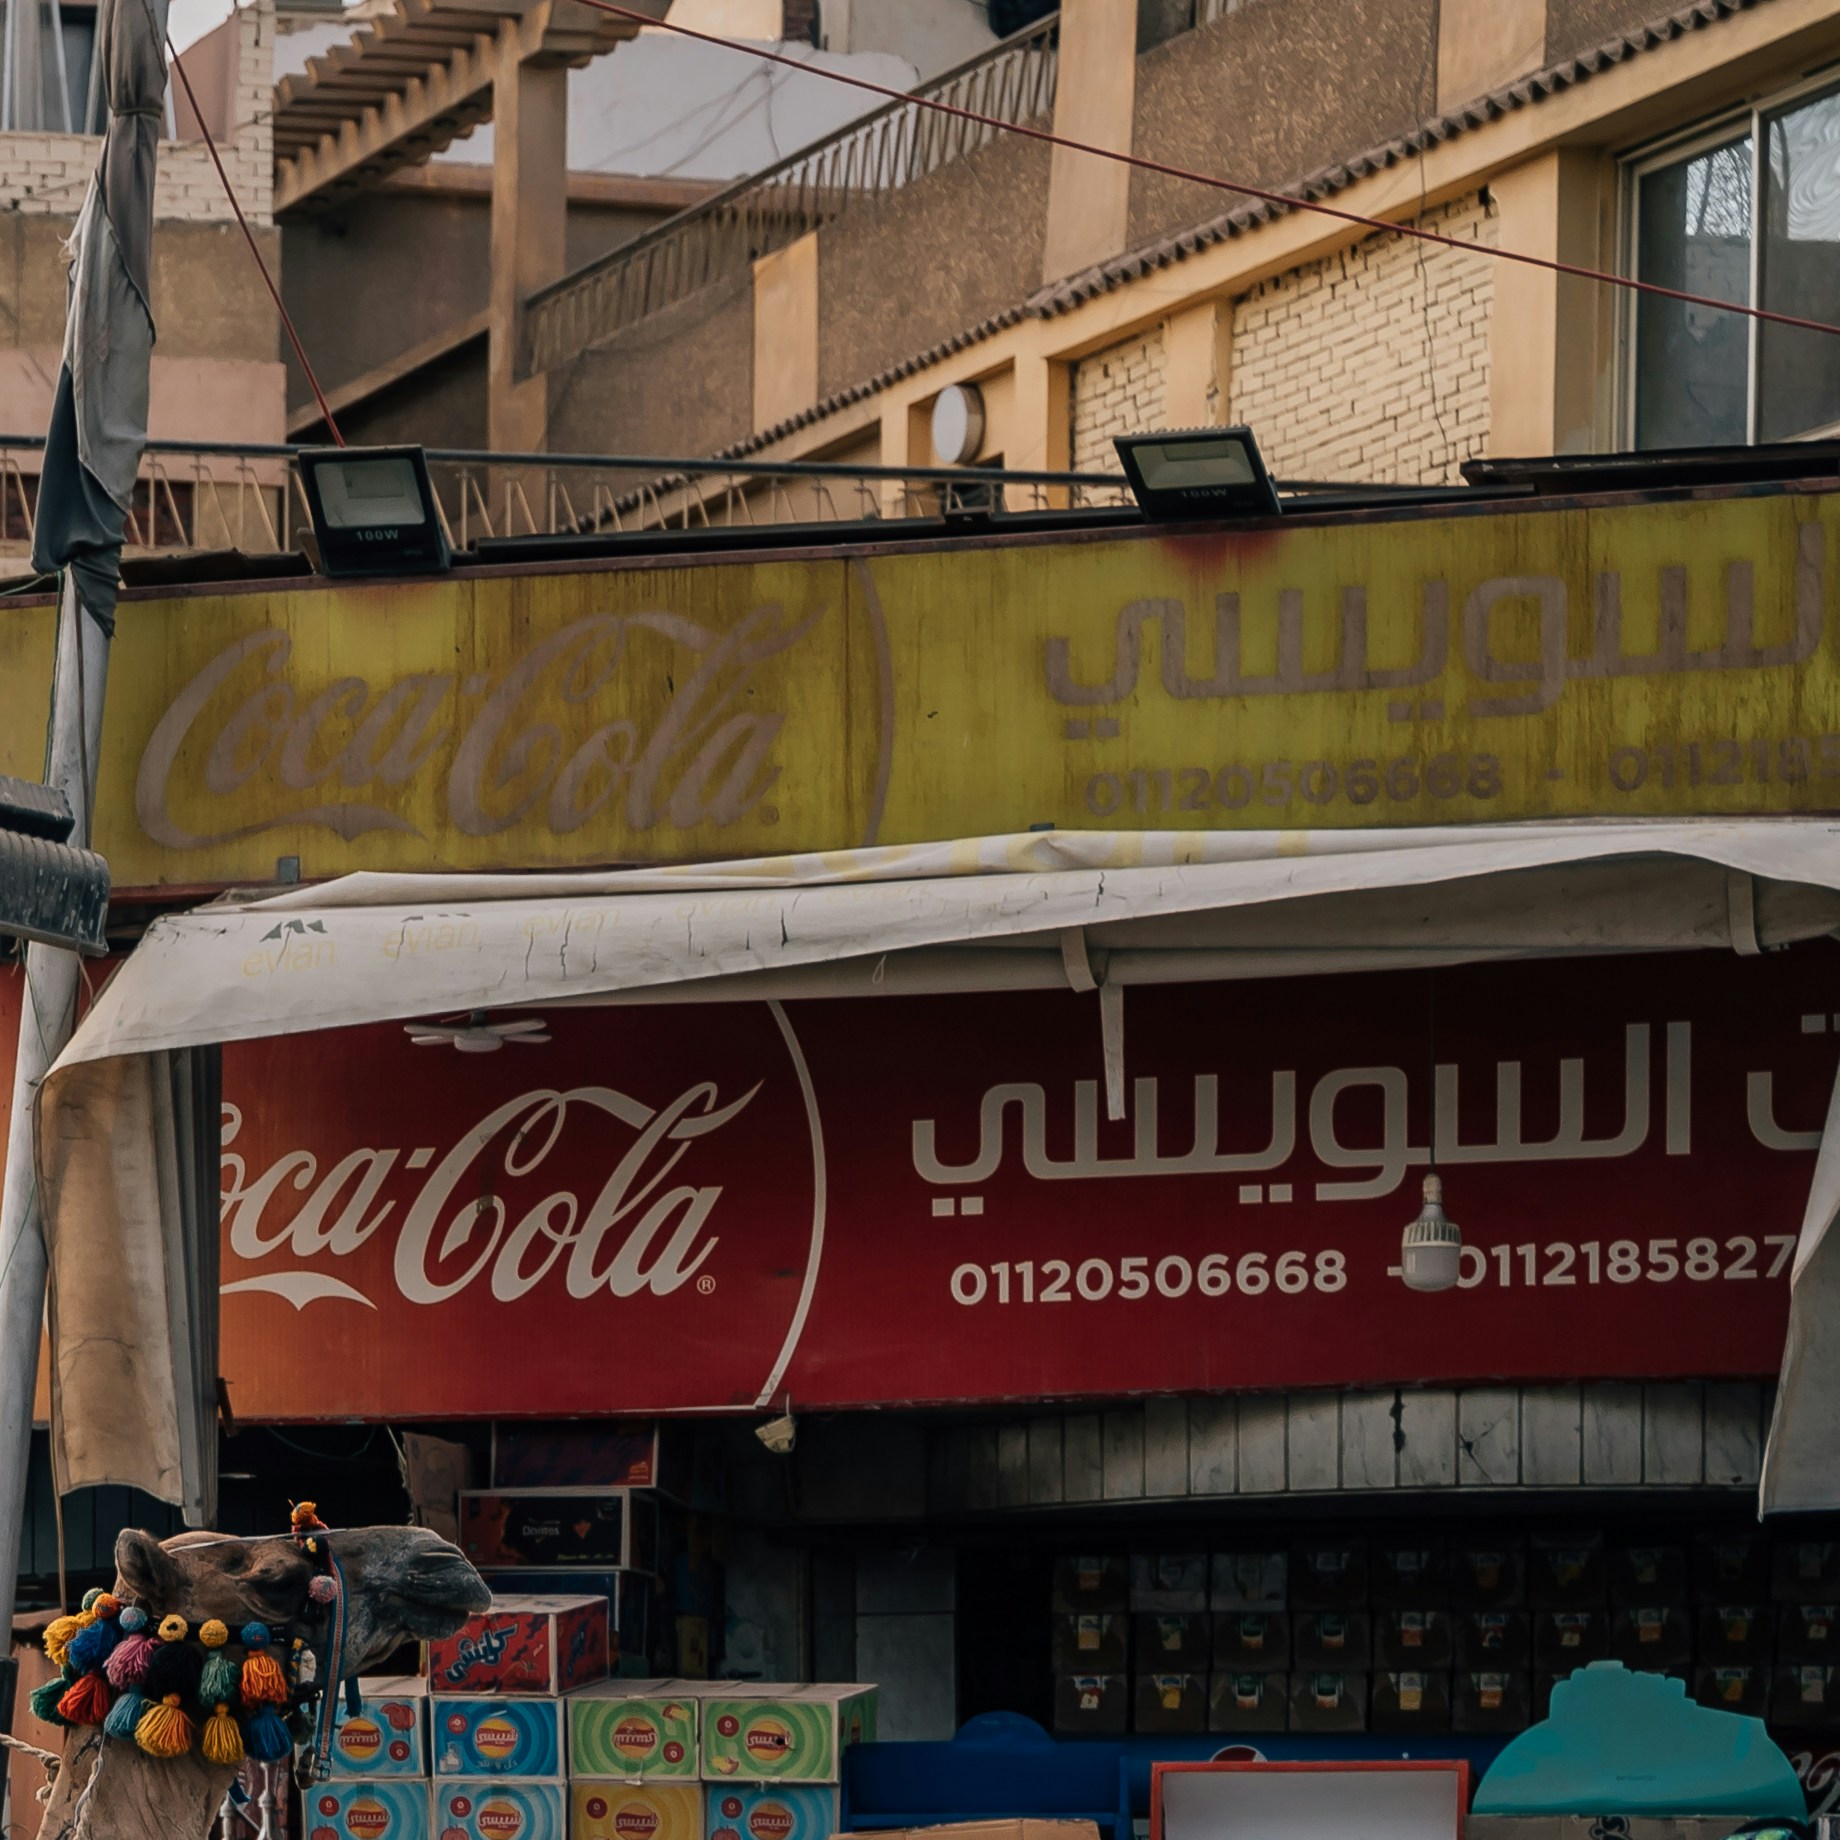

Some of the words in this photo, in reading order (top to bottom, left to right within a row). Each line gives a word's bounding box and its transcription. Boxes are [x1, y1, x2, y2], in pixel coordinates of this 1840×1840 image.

[356, 529, 399, 541] 100W
[1044, 521, 1824, 740] لسويسي
[136, 602, 827, 848] Coca-Cola
[1085, 752, 1502, 817] 01120506668
[1607, 735, 1840, 793] 0112185
[241, 940, 337, 979] evian
[382, 917, 480, 959] evian
[912, 1020, 1692, 1218] السويسي
[220, 1078, 764, 1311] oca-Cola
[950, 1249, 1348, 1306] 01120506668
[1457, 1234, 1797, 1290] 0112185827
